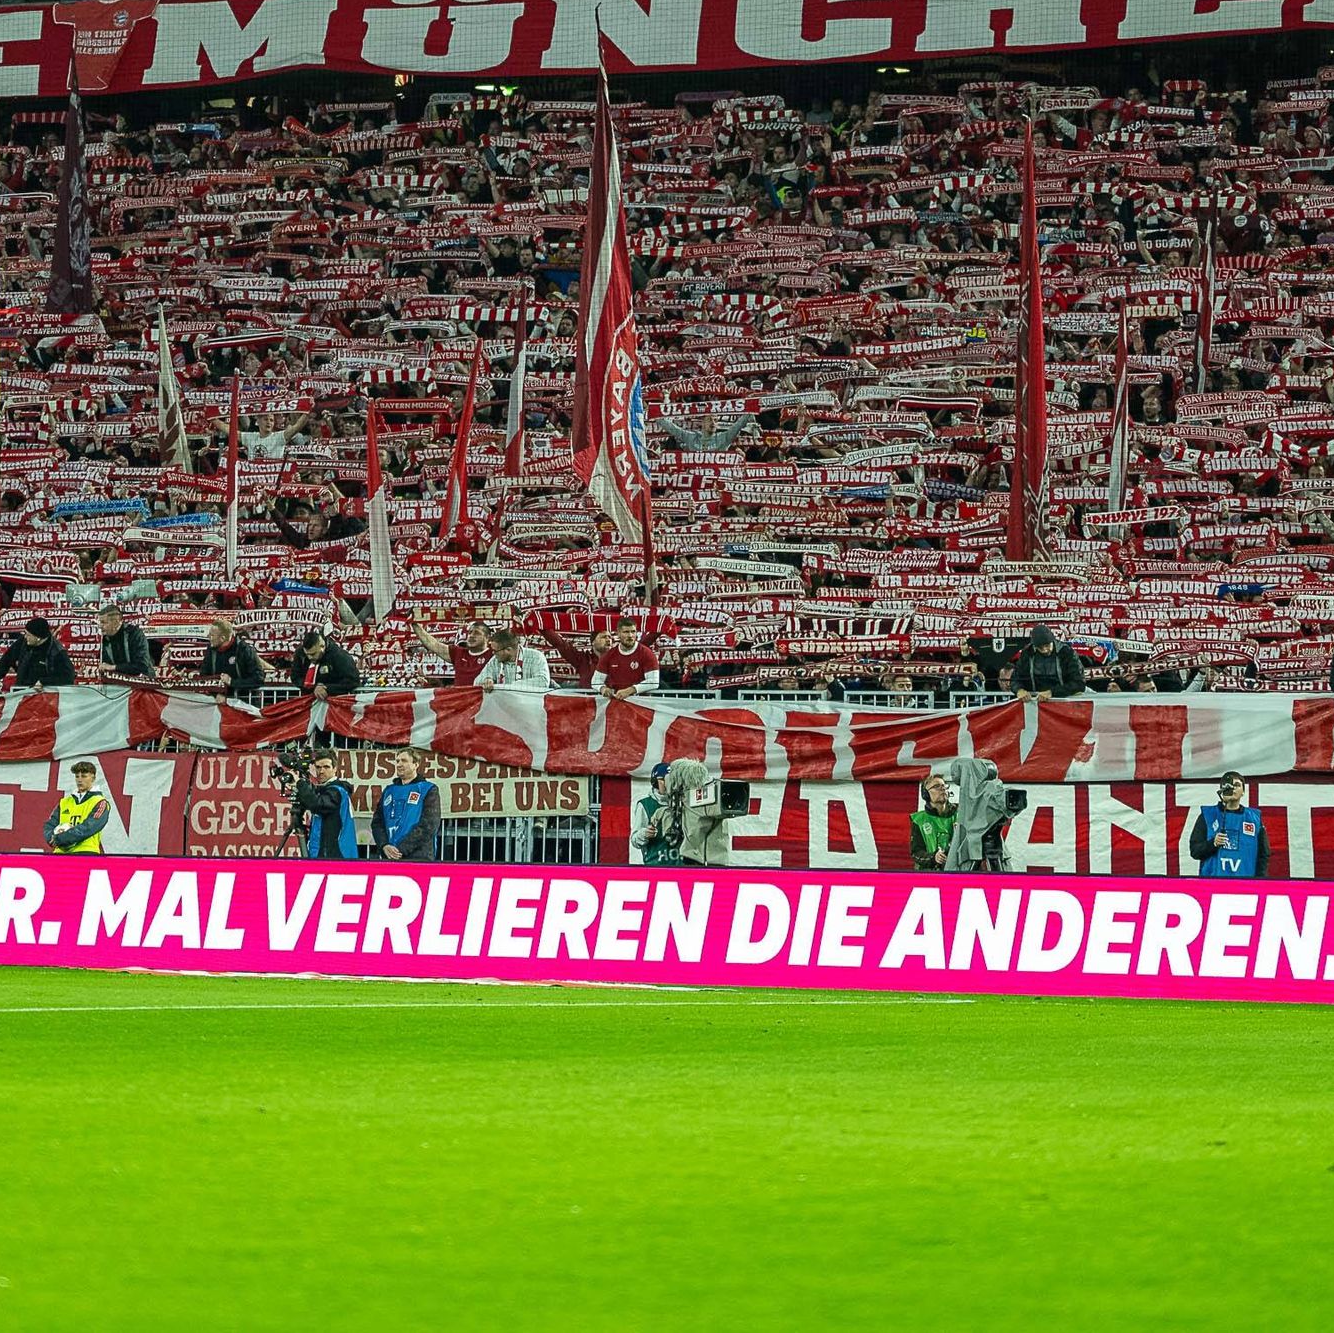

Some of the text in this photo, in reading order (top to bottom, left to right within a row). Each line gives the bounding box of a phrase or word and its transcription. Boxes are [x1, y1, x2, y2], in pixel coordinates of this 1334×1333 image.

[856, 337, 962, 355] FÜR MÜNCHEN
[747, 466, 794, 477] WIR SIND
[976, 597, 1060, 609] SÜDKURVE
[788, 640, 900, 654] SÜDKURVE
[450, 781, 580, 813] BEI UNS
[1220, 857, 1242, 873] TV
[77, 869, 245, 950] MAL
[266, 873, 714, 965] VERLIEREN
[725, 883, 875, 967] DIE
